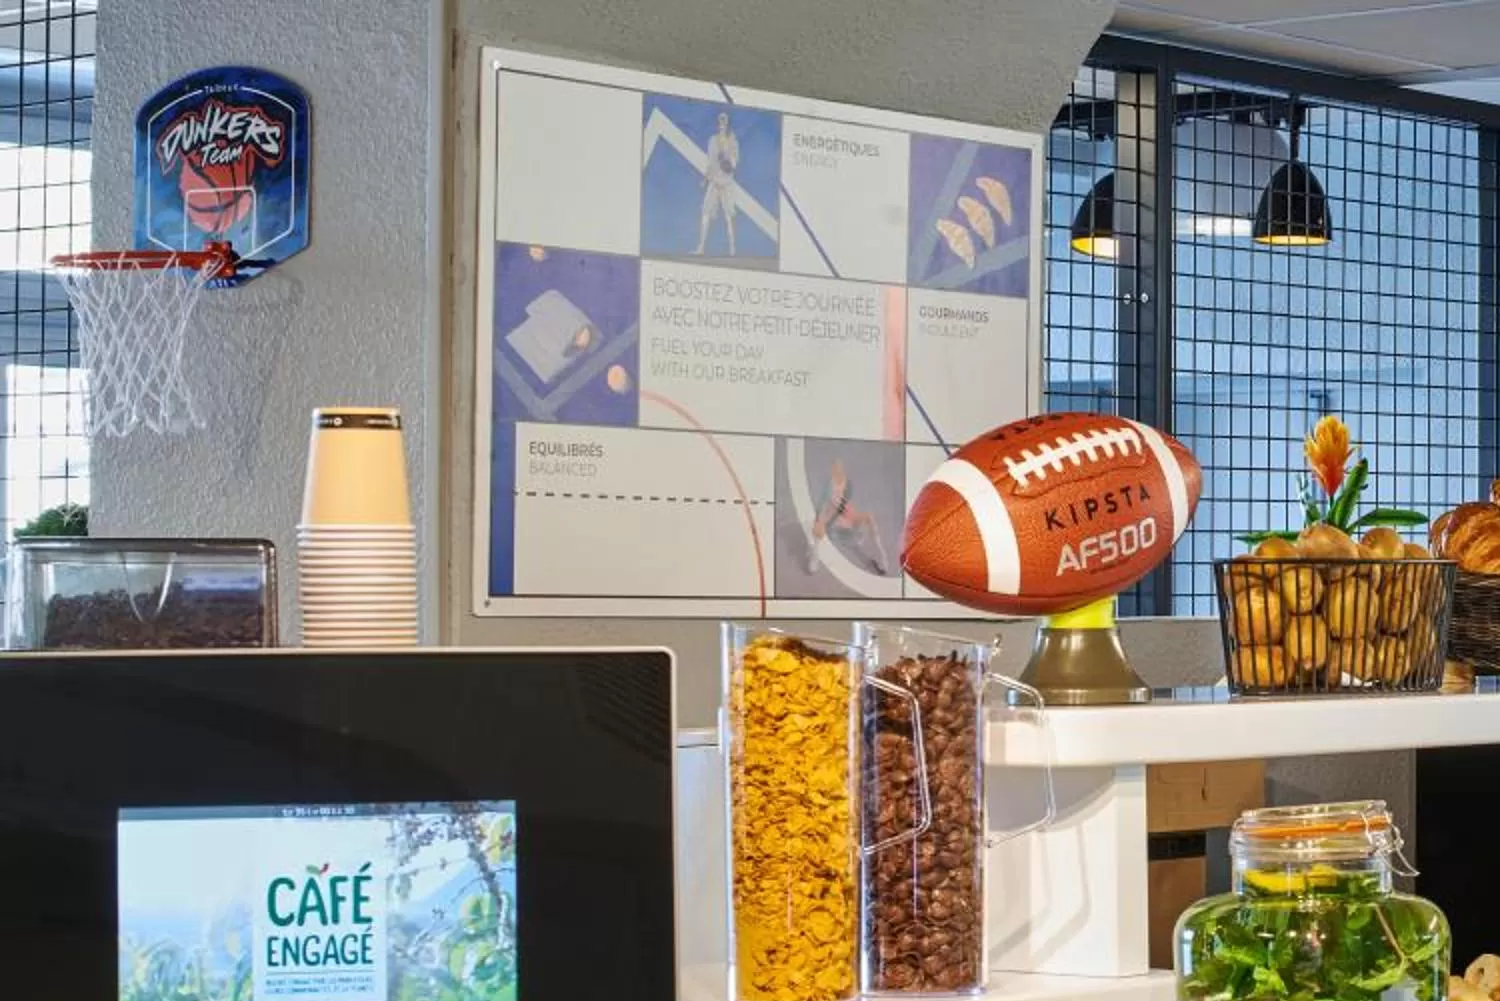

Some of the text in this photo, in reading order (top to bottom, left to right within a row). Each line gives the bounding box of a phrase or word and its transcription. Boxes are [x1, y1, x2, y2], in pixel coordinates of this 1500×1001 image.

[161, 103, 281, 163] DUNKERS
[653, 277, 734, 303] BOOSTEZ
[735, 286, 793, 308] VOTRE
[651, 305, 695, 328] AVEC
[697, 308, 753, 334] NOTRE
[651, 360, 689, 379] WITH
[728, 365, 811, 388] BREAKFAST
[1043, 484, 1151, 531] KIPSTA
[1055, 516, 1158, 577] AF500
[266, 861, 374, 927] CAFÉ
[266, 926, 375, 968] ENGAGÉ
